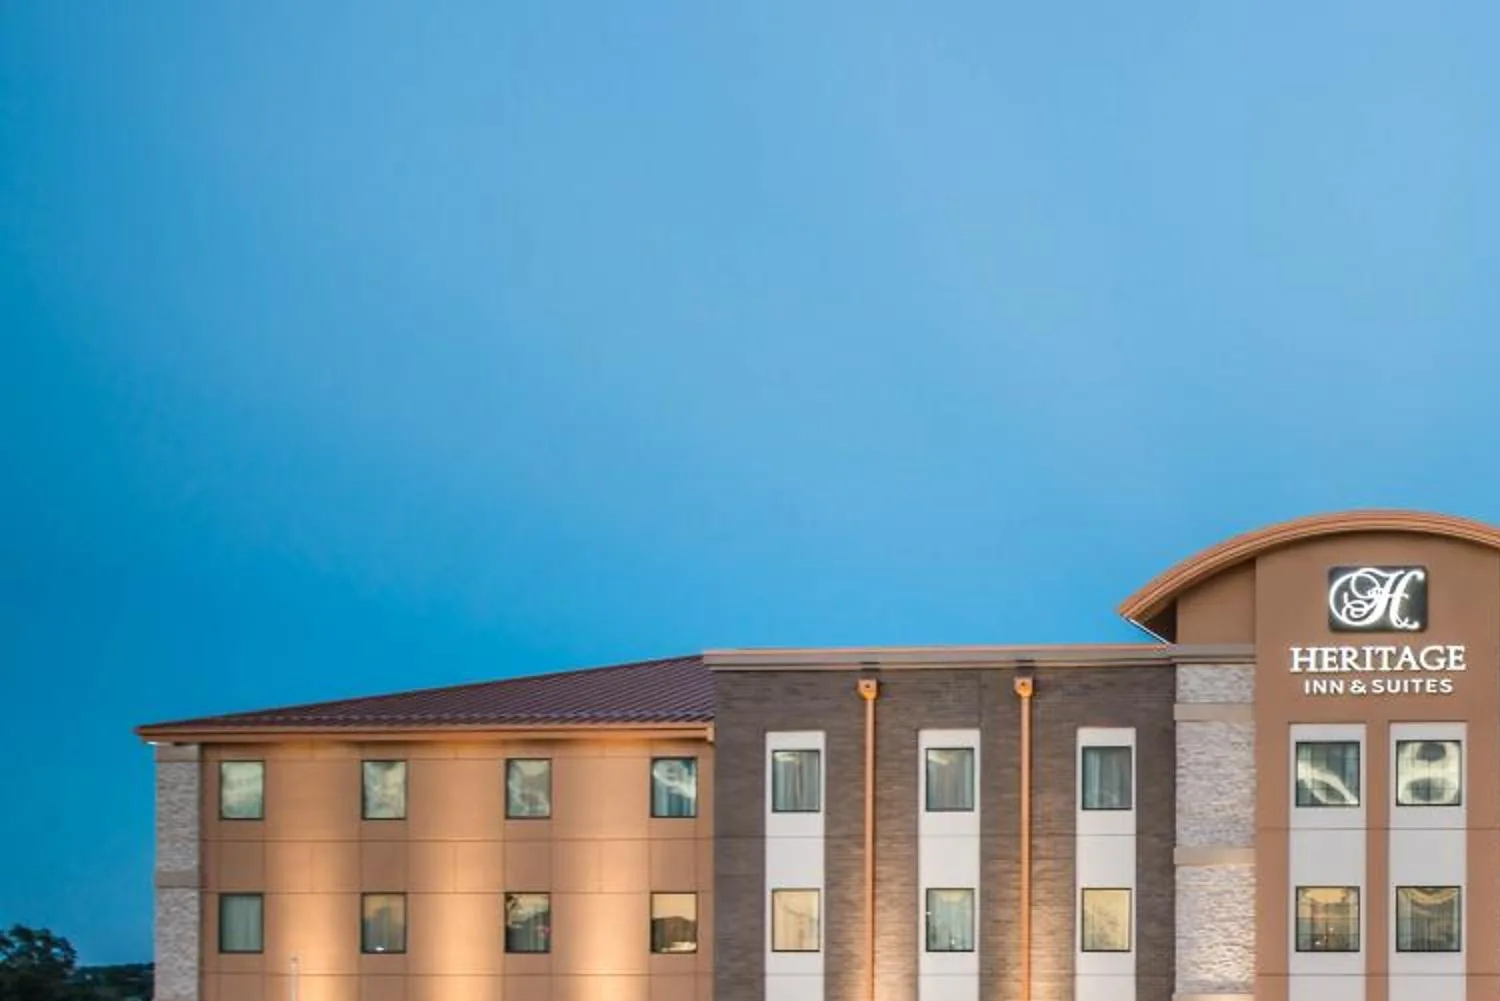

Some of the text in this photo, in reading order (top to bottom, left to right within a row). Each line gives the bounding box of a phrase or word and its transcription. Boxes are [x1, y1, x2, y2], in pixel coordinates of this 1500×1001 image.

[1289, 645, 1467, 673] HERITAGE
[1304, 678, 1454, 696] INN & SUITES
